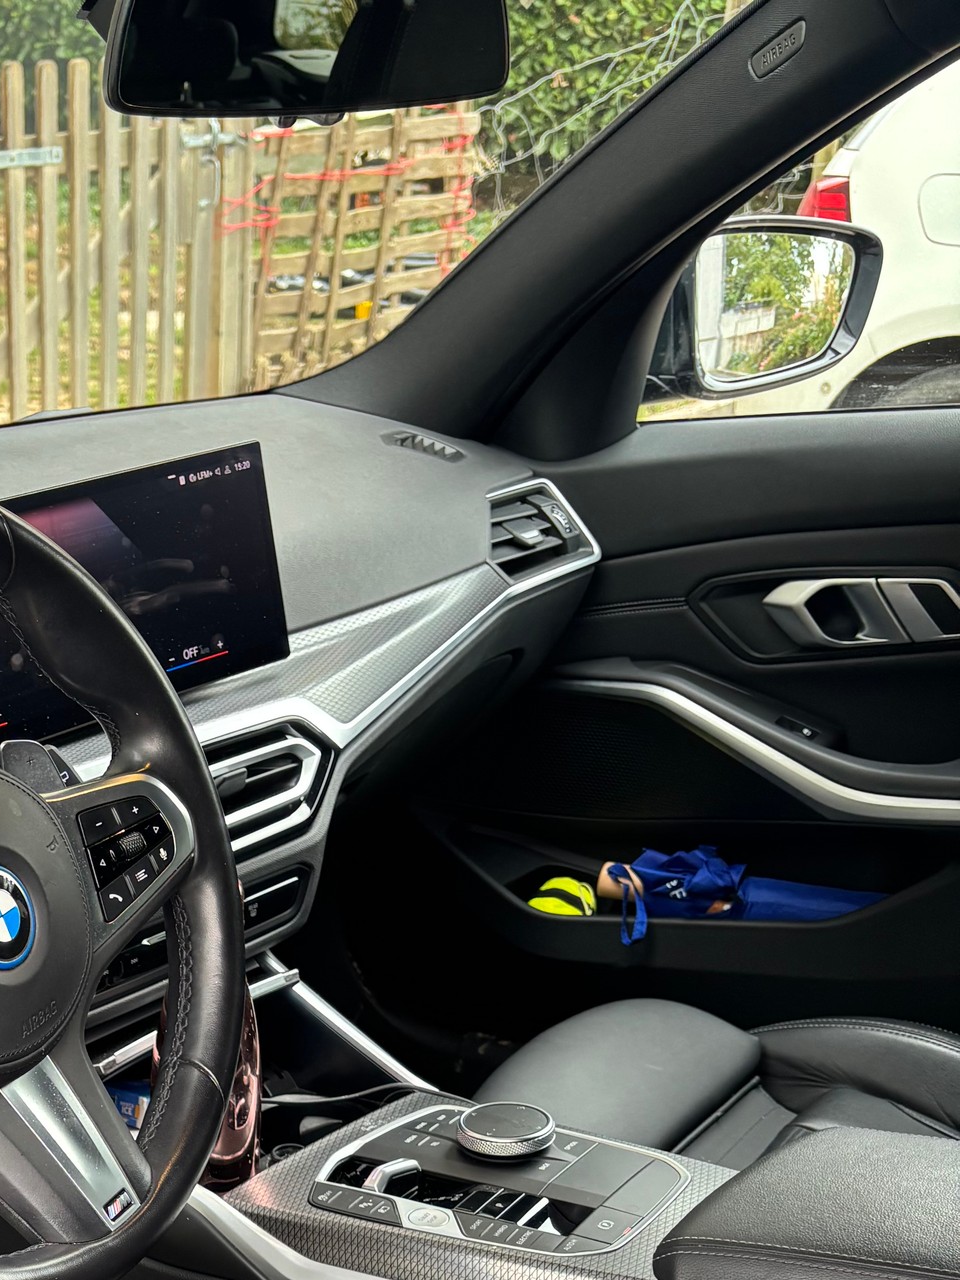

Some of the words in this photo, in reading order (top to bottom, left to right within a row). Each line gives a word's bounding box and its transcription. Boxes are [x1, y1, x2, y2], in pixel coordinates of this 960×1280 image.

[760, 32, 796, 69] AIRBAG
[183, 645, 199, 660] OFF
[22, 1000, 58, 1039] AIRBAG
